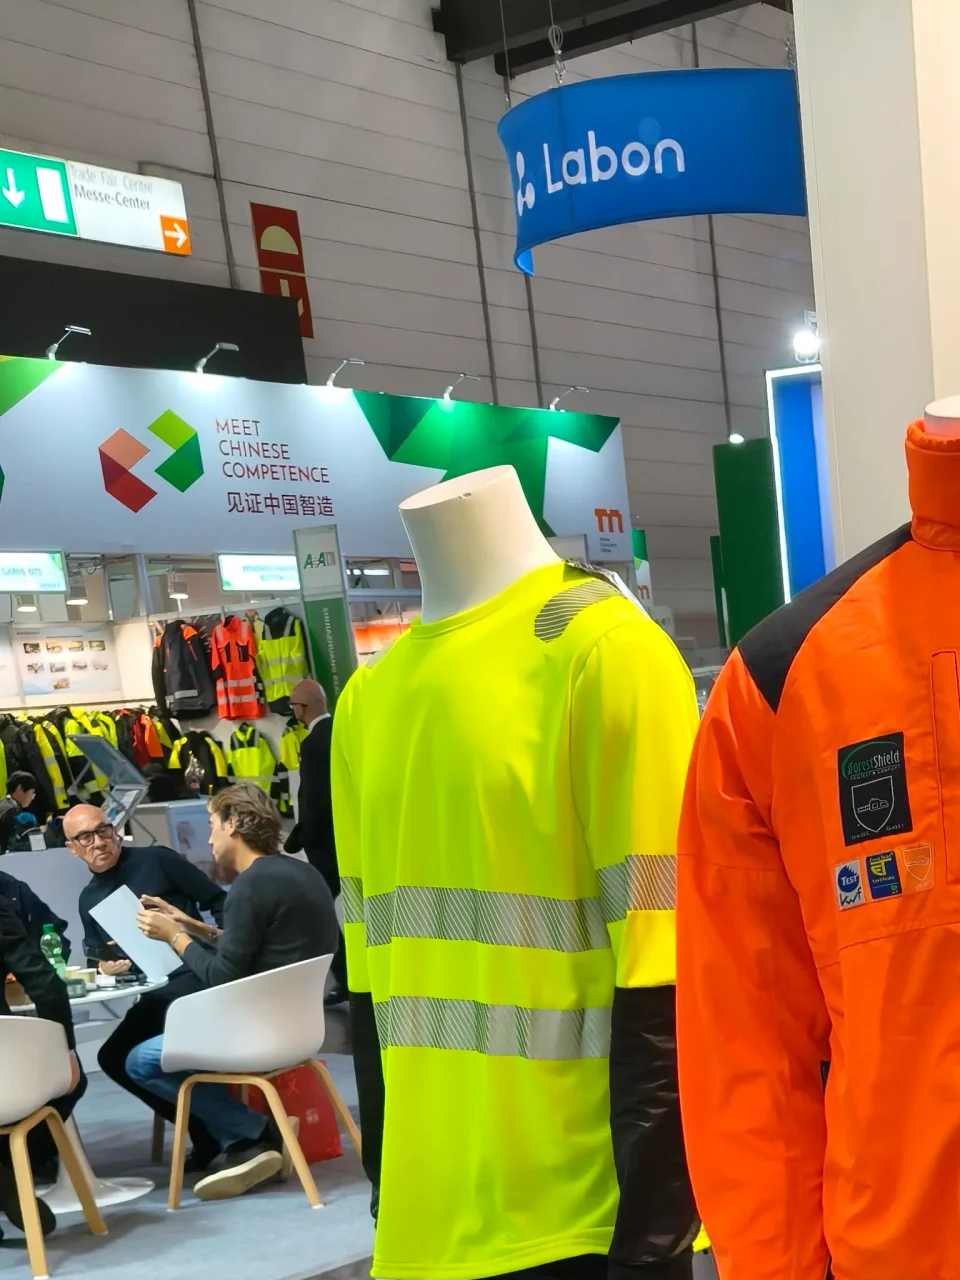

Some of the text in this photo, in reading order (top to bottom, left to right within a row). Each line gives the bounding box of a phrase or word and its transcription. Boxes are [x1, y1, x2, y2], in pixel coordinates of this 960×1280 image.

[70, 163, 97, 183] Trade
[543, 130, 686, 194] Labon
[73, 183, 152, 212] Messe-Center
[215, 417, 261, 437] MEET
[218, 440, 290, 460] CHINESE
[222, 461, 330, 483] COMPETENCE
[226, 491, 335, 517] 见证中国智造
